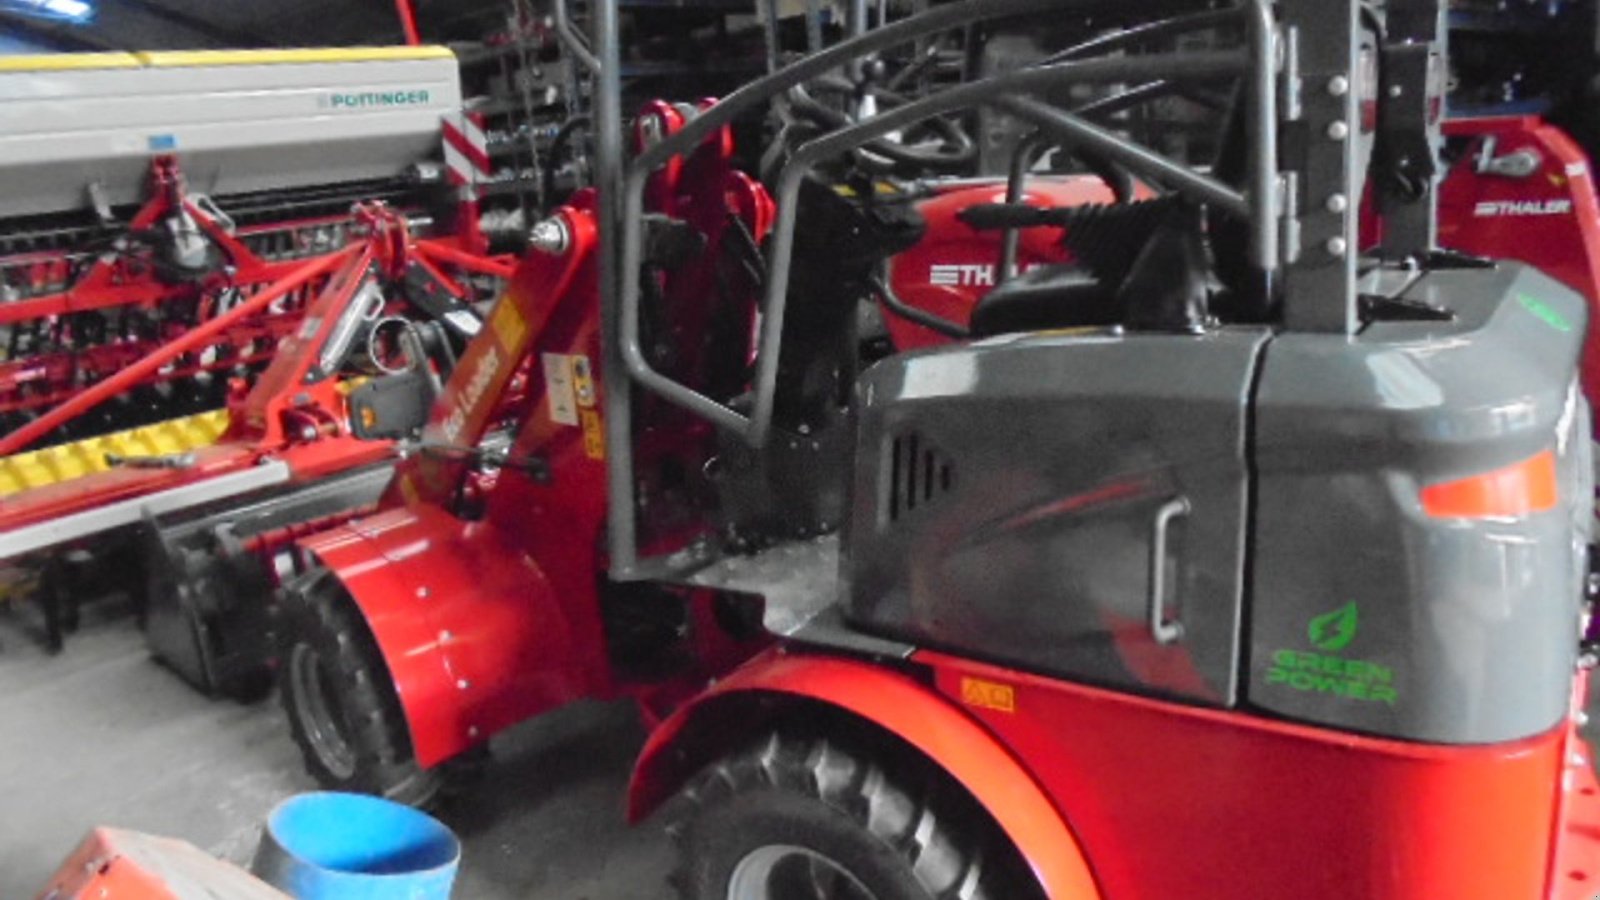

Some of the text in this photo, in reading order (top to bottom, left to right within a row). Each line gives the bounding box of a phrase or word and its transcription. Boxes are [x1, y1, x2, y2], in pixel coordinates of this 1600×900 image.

[1498, 199, 1570, 215] THALER
[1273, 650, 1394, 683] GREEN
[1264, 667, 1398, 704] POWER
